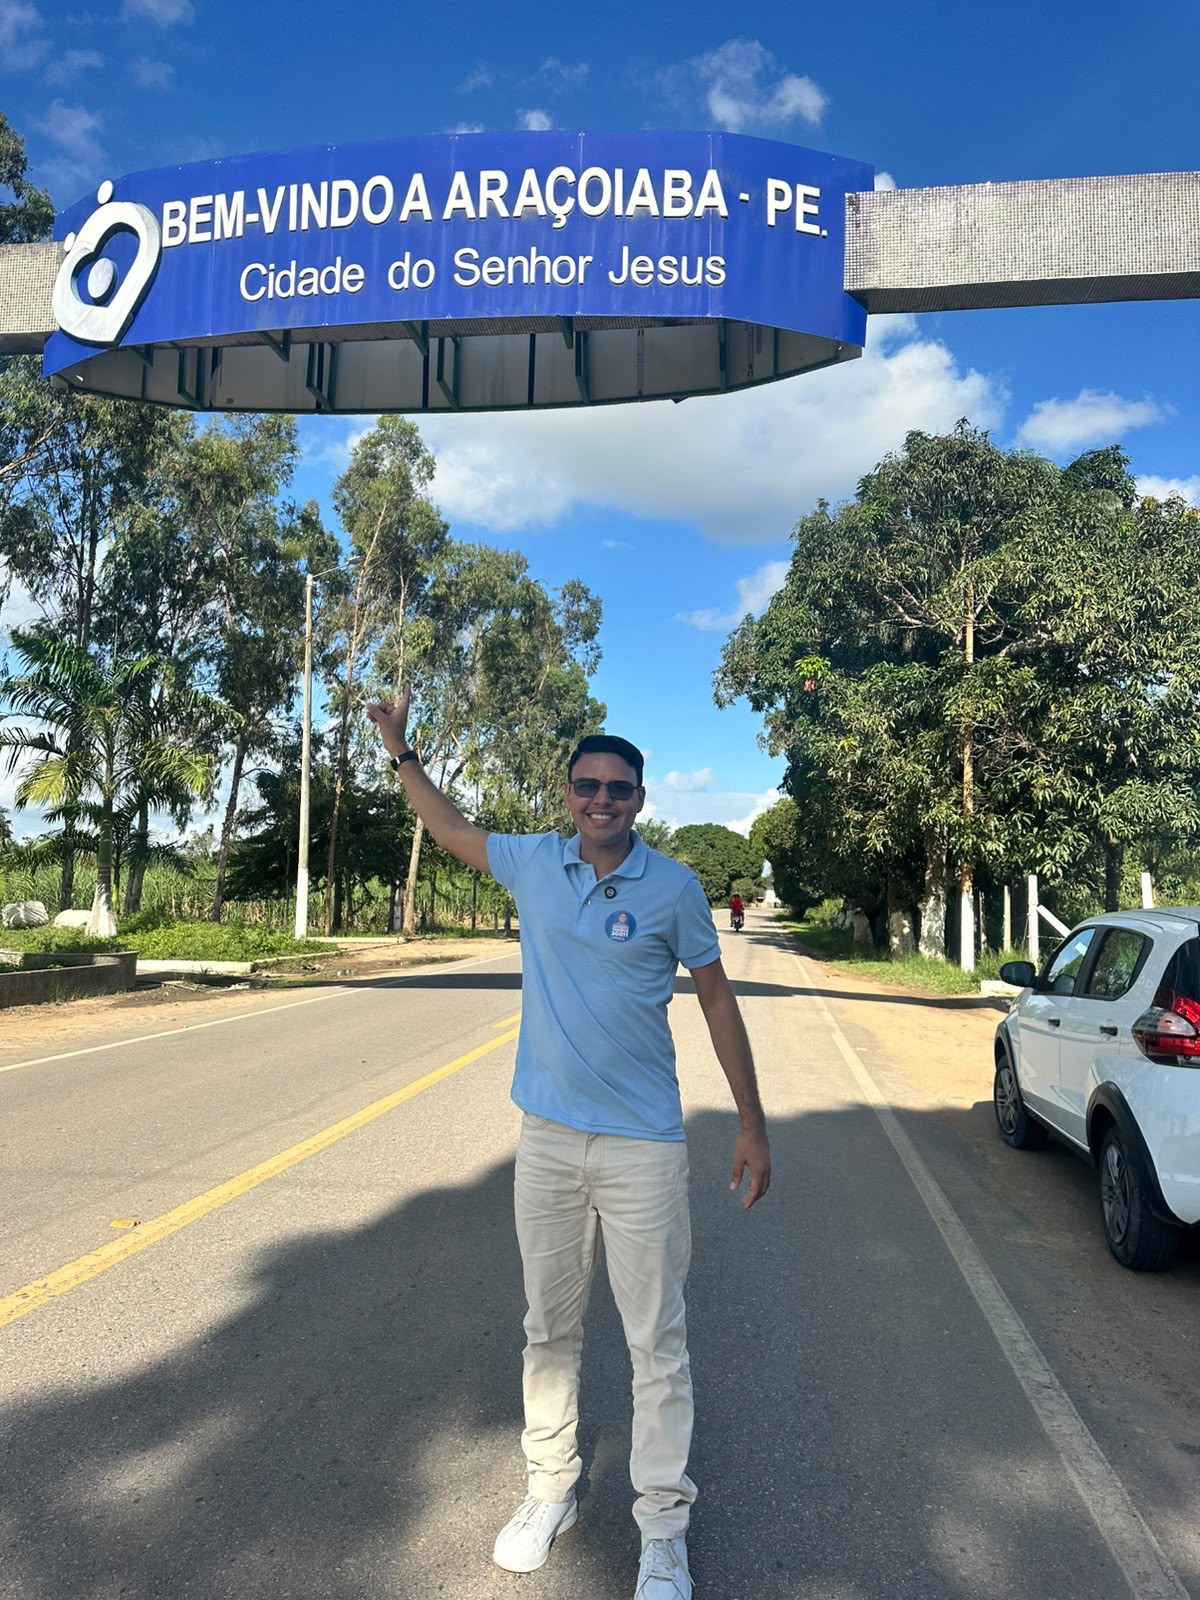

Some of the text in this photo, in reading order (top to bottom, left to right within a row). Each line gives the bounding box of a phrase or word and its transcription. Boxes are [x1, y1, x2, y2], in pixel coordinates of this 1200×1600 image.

[161, 175, 394, 248] BEM-VINDO
[399, 173, 433, 222] A
[442, 166, 729, 228] ARAÇOIABA
[766, 177, 828, 237] PE.
[239, 246, 727, 301] Cidade do Senhor Jesus
